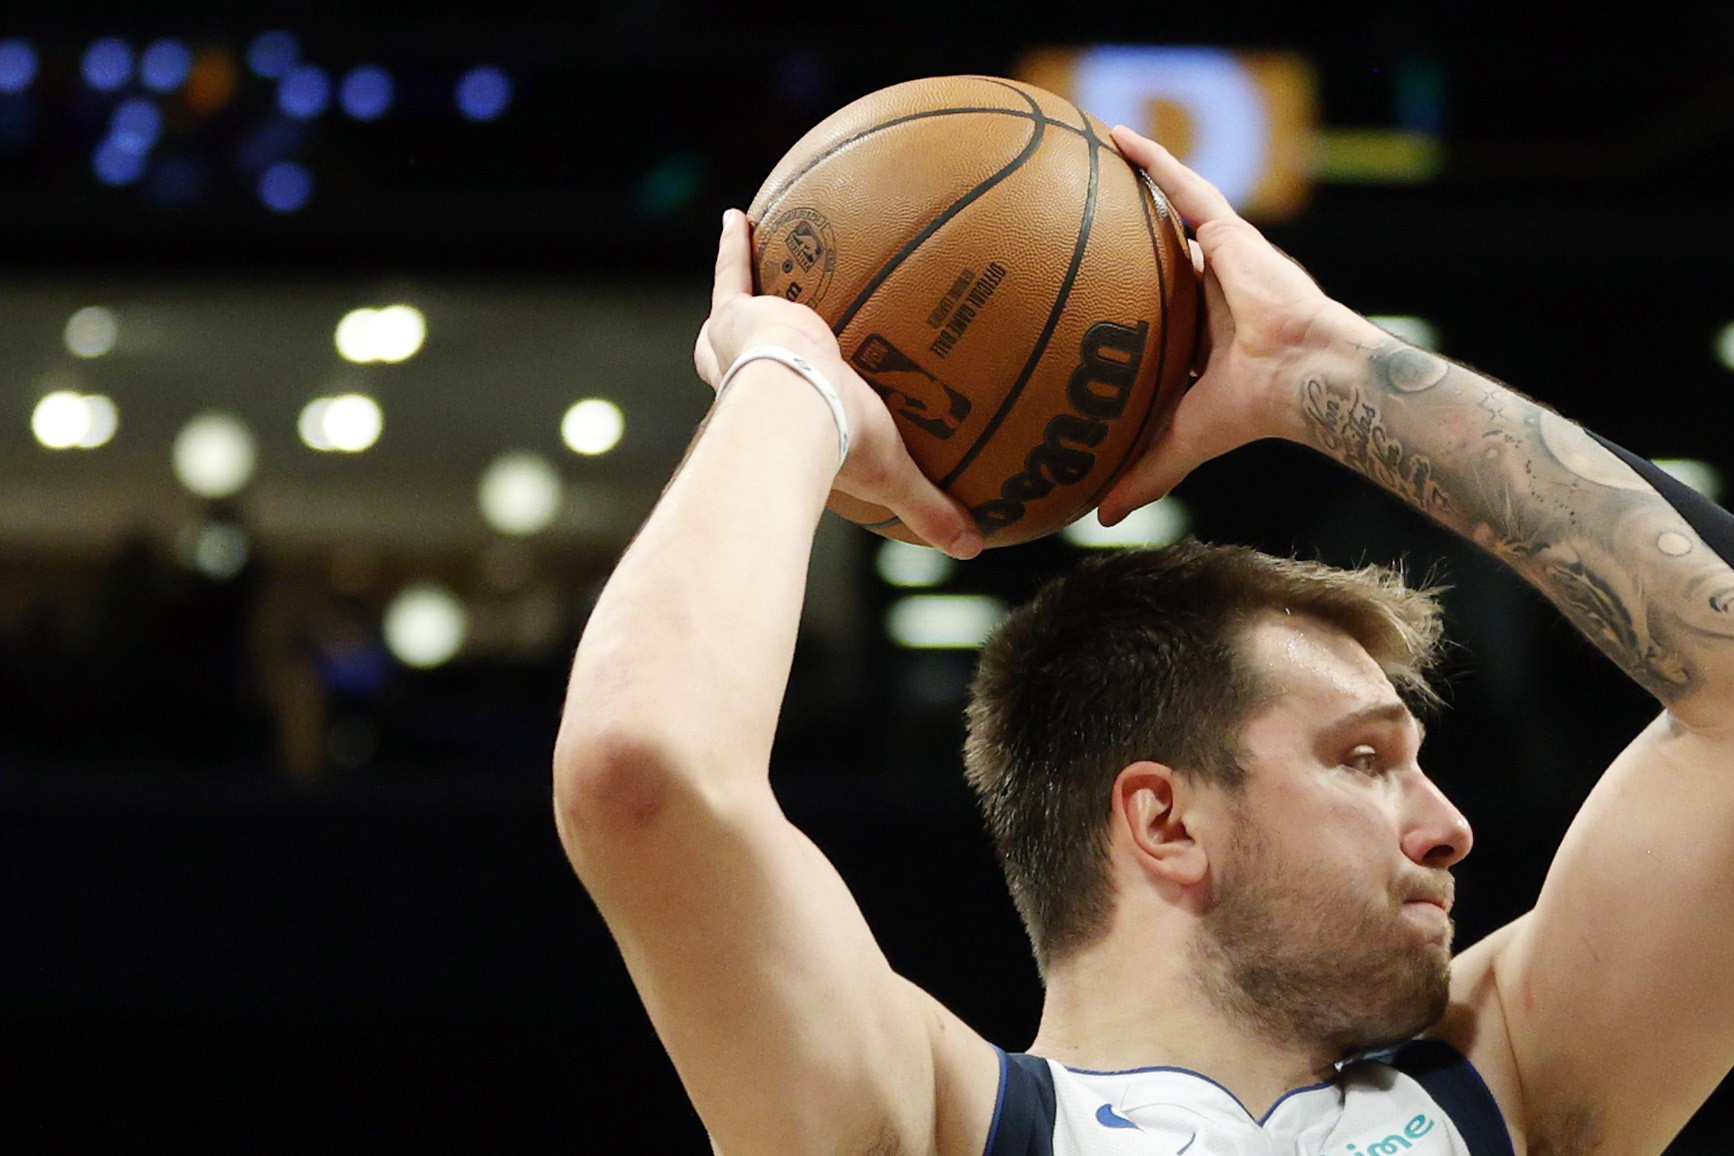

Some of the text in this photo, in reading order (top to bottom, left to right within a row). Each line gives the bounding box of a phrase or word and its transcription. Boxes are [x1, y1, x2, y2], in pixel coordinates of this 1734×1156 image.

[967, 262, 1008, 309] OFFICIAL
[946, 303, 977, 338] GAME
[928, 329, 957, 359] BALL
[970, 320, 1150, 535] Wilso
